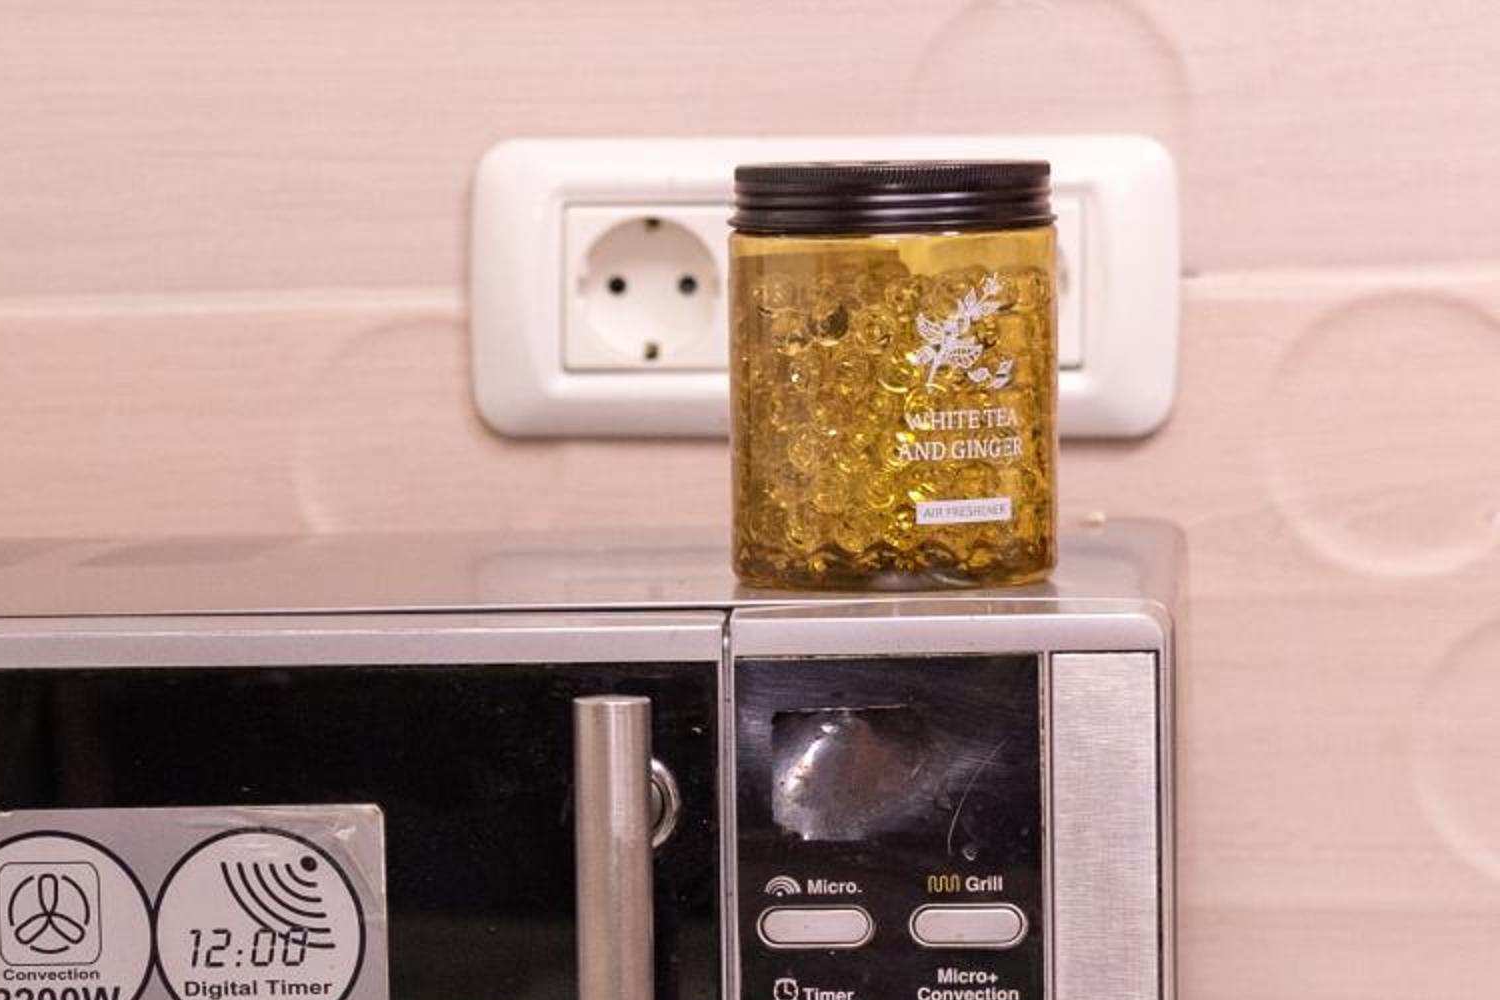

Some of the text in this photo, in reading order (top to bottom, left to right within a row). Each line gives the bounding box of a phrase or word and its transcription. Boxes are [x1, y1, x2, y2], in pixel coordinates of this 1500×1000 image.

[904, 407, 1020, 431] WHITE TEA
[899, 437, 1023, 461] AND GINGER
[806, 878, 863, 895] Micro.
[964, 875, 1003, 892] Grill
[188, 928, 308, 969] 12:00
[3, 967, 100, 982] Convection
[937, 967, 999, 984] Micro+
[184, 979, 333, 999] Digital Timer
